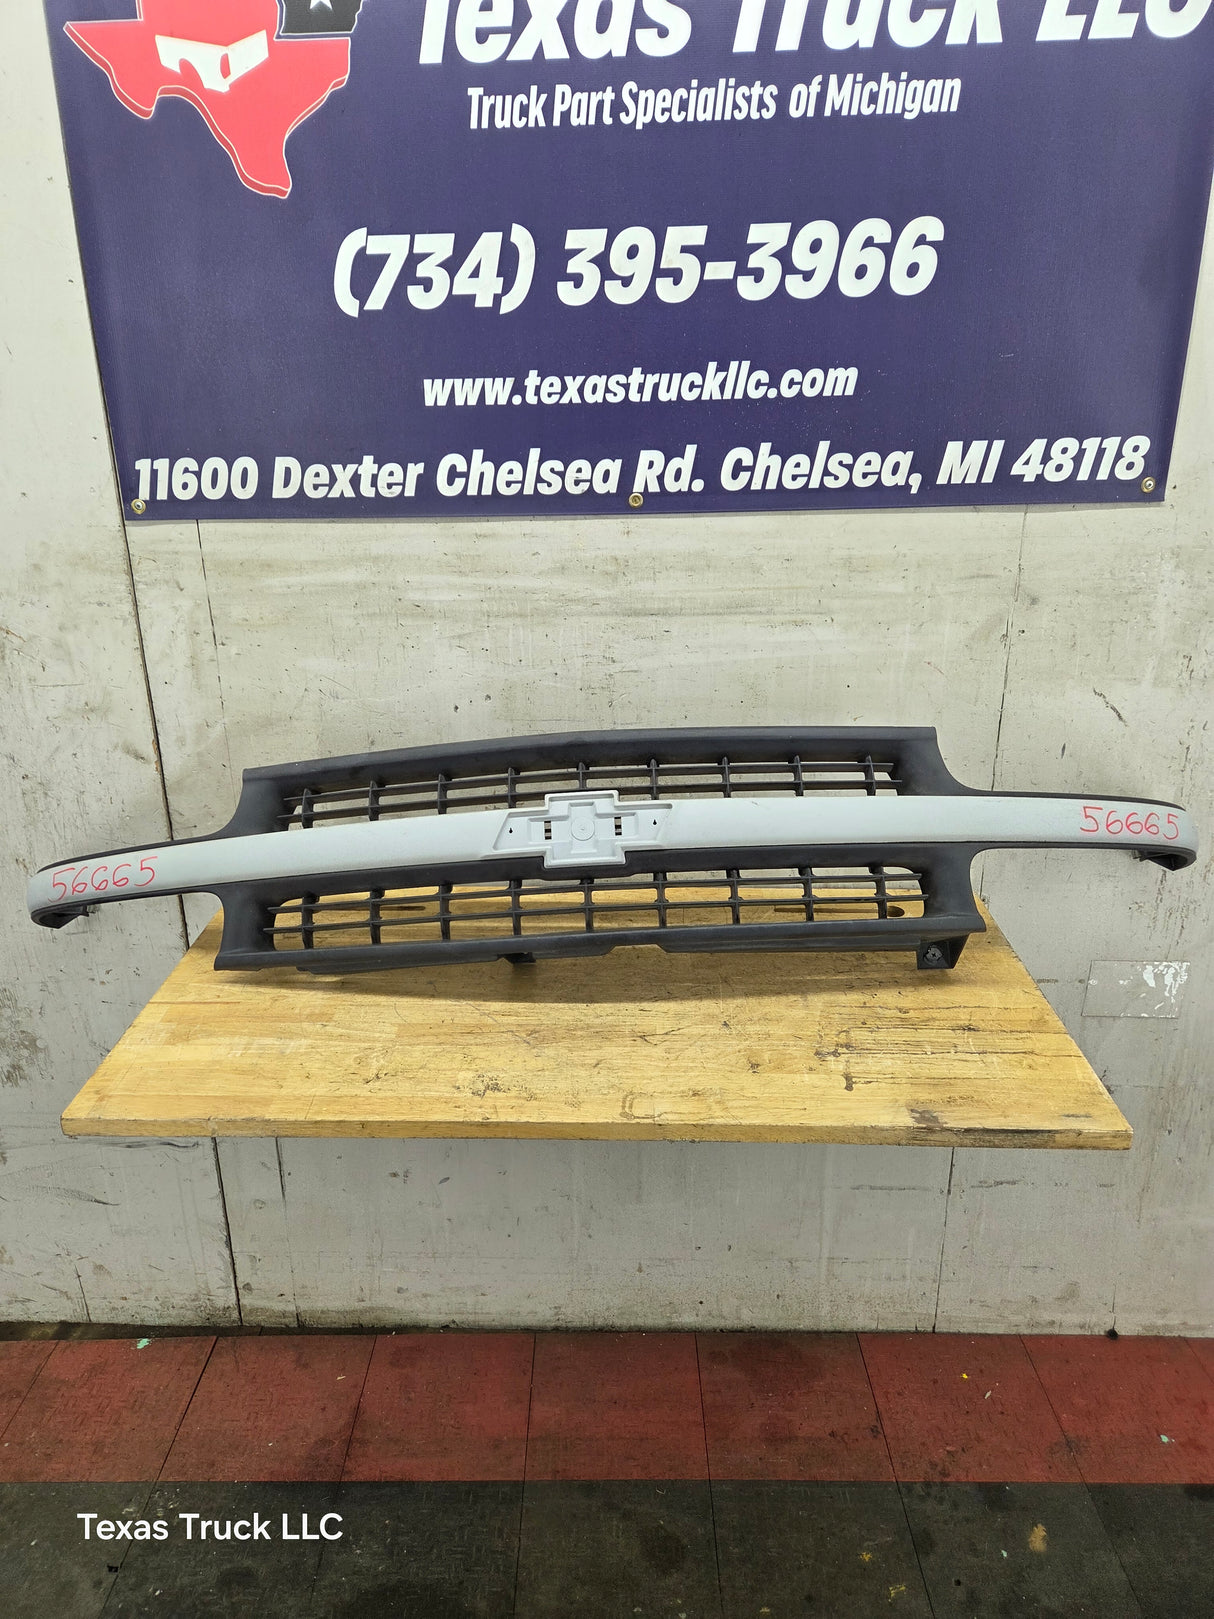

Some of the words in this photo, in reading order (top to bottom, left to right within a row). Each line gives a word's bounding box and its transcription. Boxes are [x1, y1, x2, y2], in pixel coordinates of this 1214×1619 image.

[467, 84, 548, 130] Truck
[552, 83, 616, 127] Part
[619, 77, 778, 130] Specialists
[788, 75, 823, 118] of
[823, 71, 962, 120] Michigan
[333, 223, 536, 318] (734)
[556, 215, 945, 307] 395-3966
[423, 360, 859, 407] www.texastruckllc.com
[133, 456, 259, 501] 11600
[271, 455, 425, 499] Dexter
[436, 447, 623, 497] Chelsea
[632, 444, 705, 493] Rd.
[720, 440, 923, 495] Chelsea,
[935, 439, 1005, 485] MI
[1010, 435, 1153, 483] 48118
[1079, 805, 1180, 841] 56665
[47, 855, 159, 903] 56665
